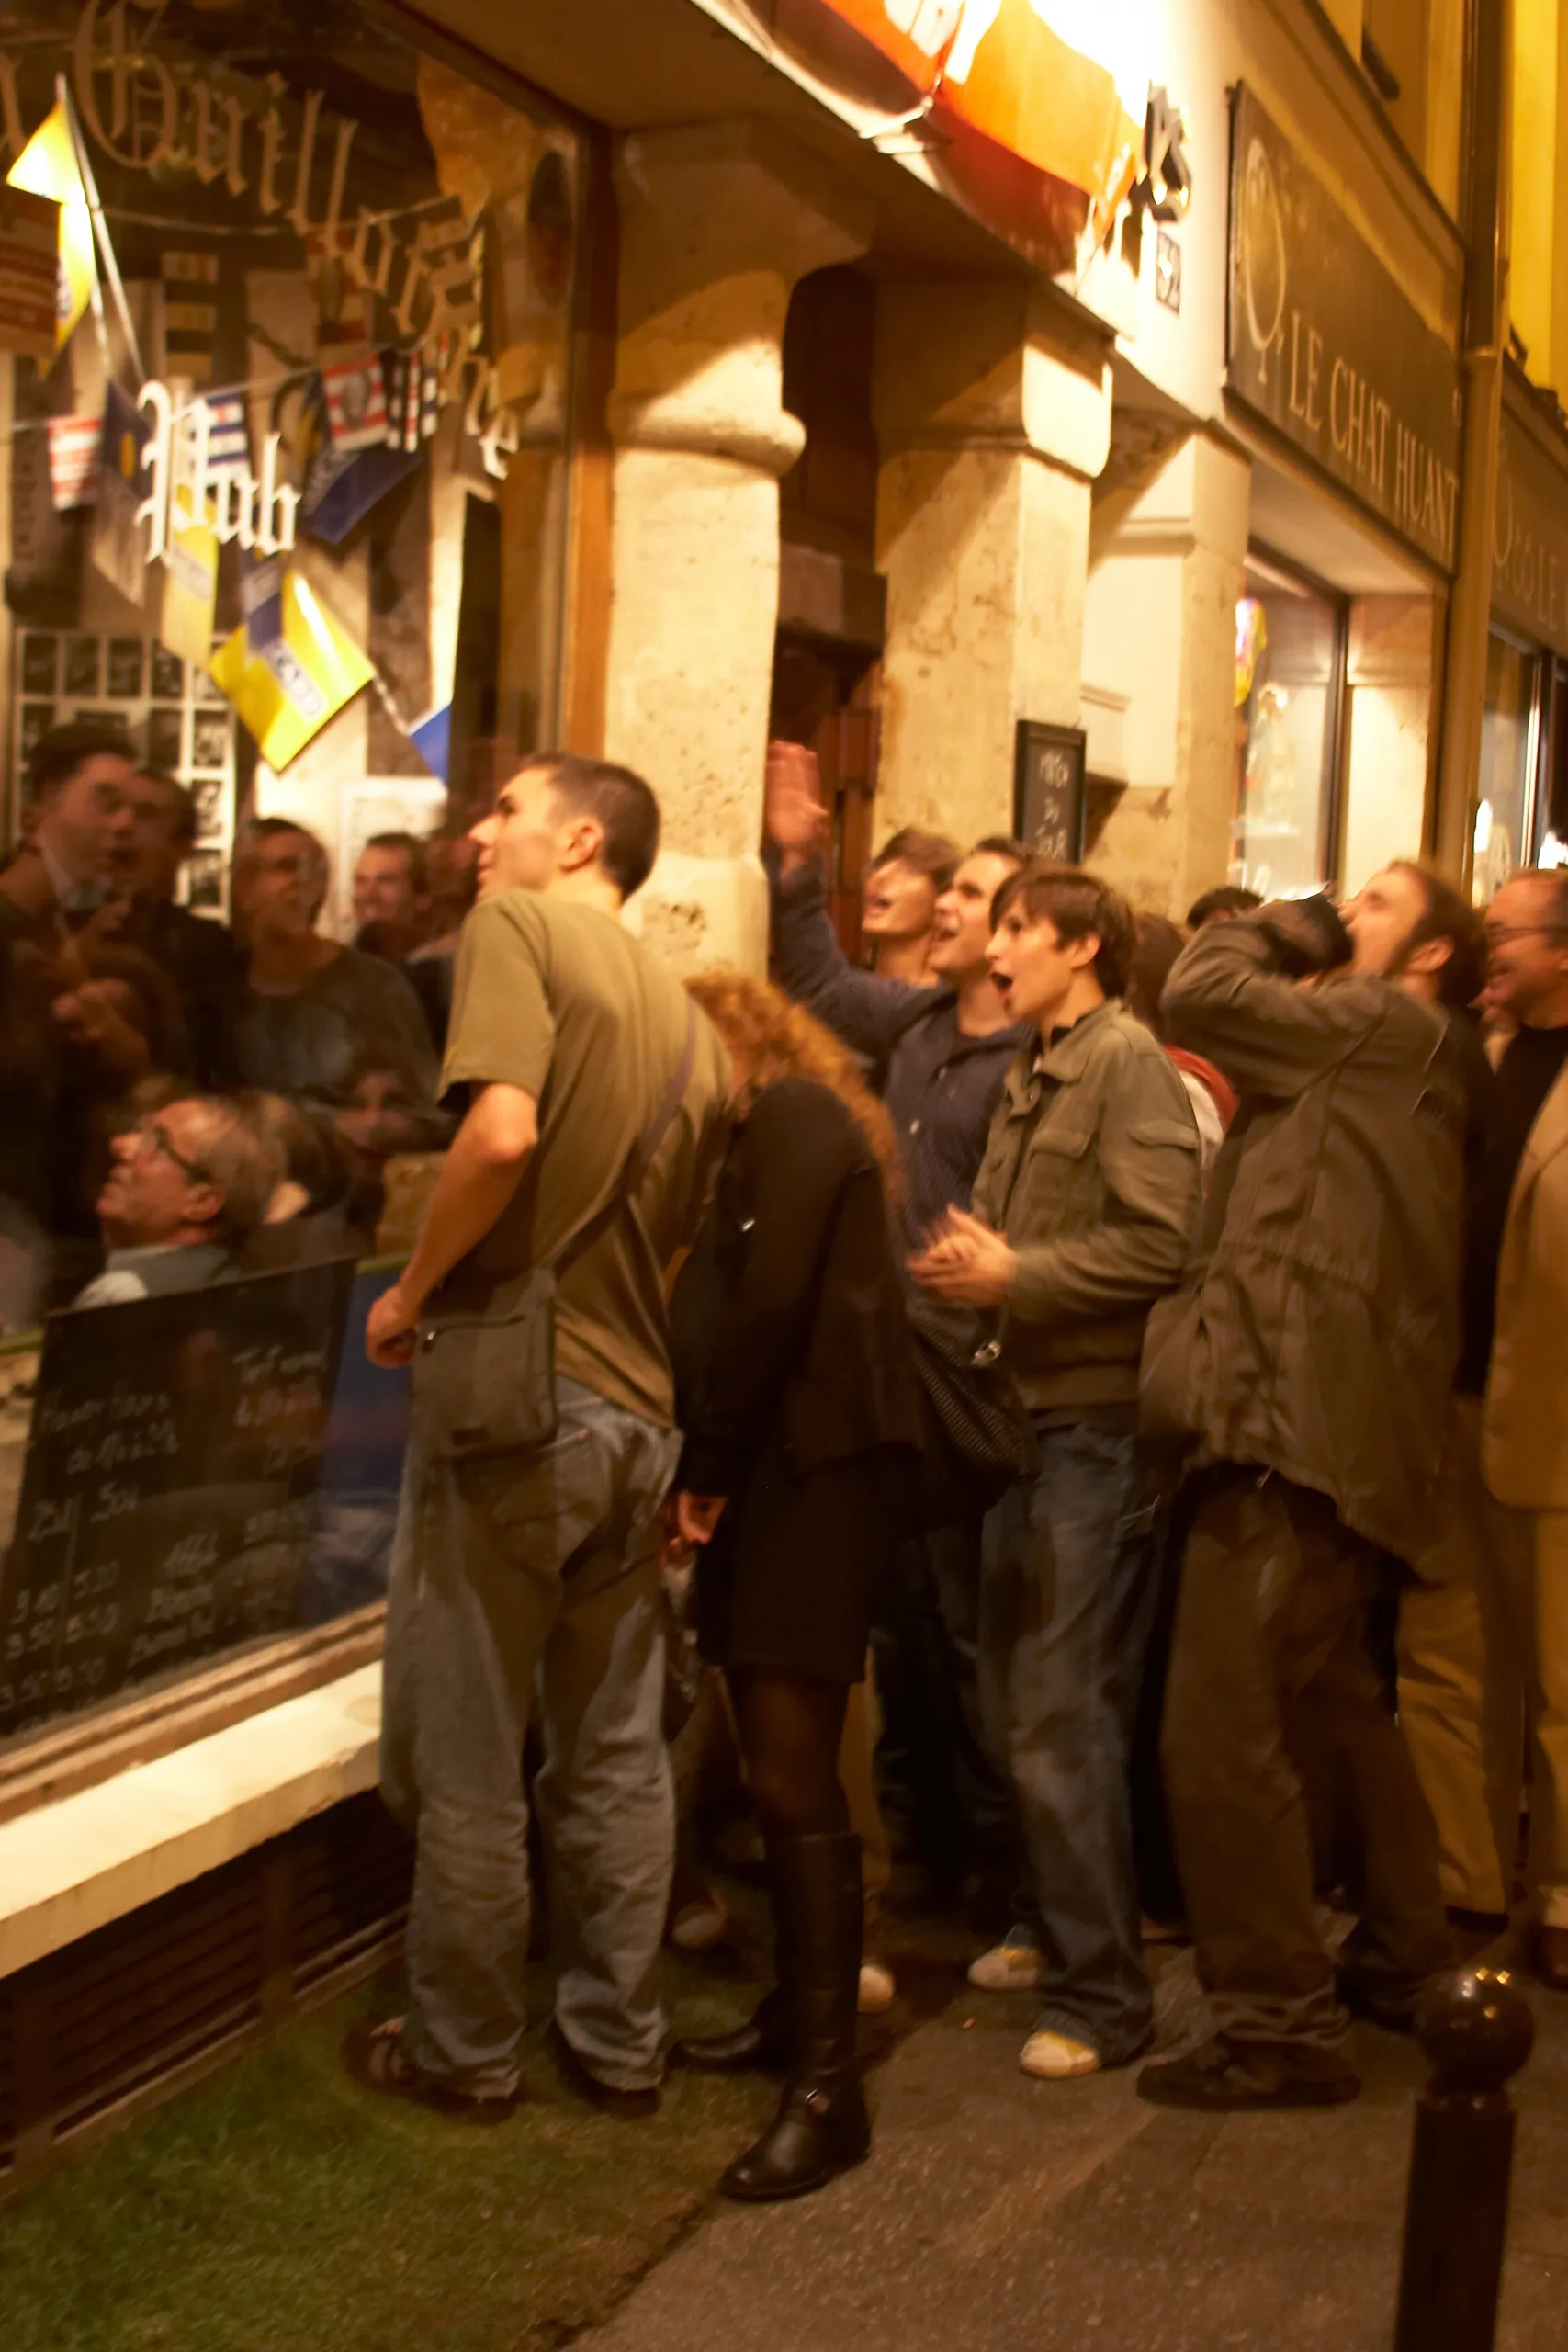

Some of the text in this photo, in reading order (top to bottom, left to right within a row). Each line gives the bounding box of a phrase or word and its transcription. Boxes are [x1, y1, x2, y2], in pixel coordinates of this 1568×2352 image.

[133, 379, 301, 565] Pub
[1288, 308, 1459, 560] LE CHAT HUANT
